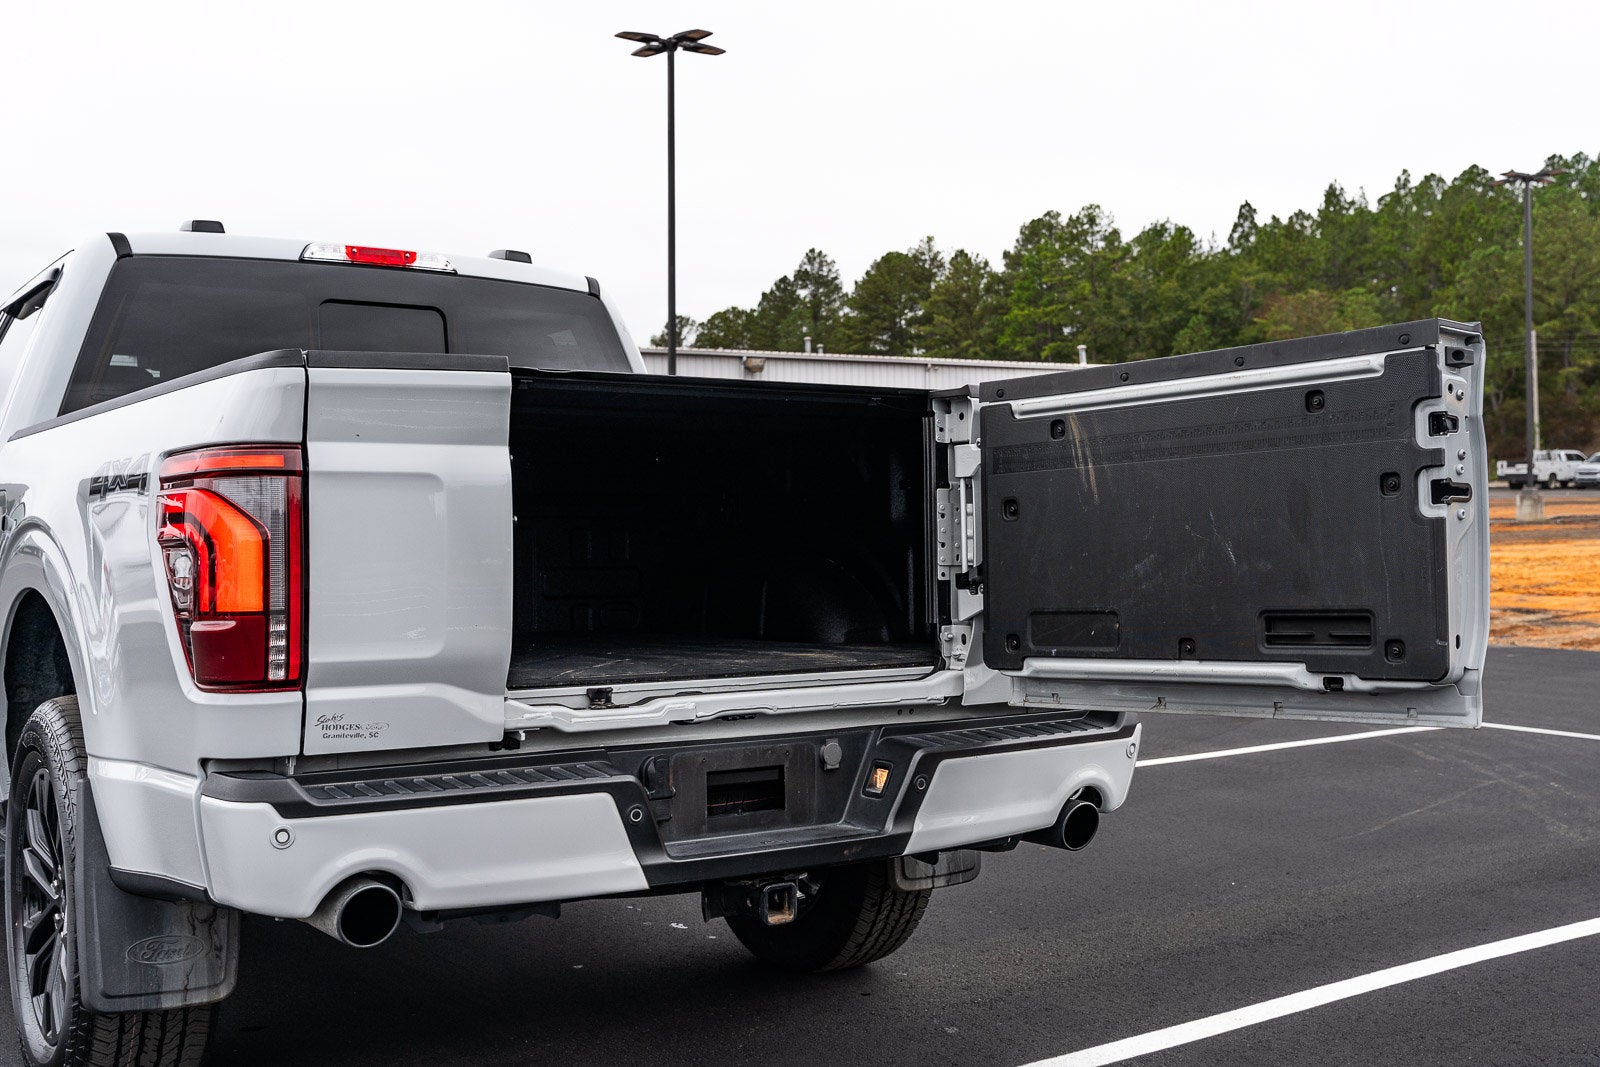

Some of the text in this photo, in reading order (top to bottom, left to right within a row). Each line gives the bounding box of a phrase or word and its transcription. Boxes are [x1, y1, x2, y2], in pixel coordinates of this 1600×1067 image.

[322, 731, 380, 740] Graniteville, SC
[140, 940, 192, 962] Ford
